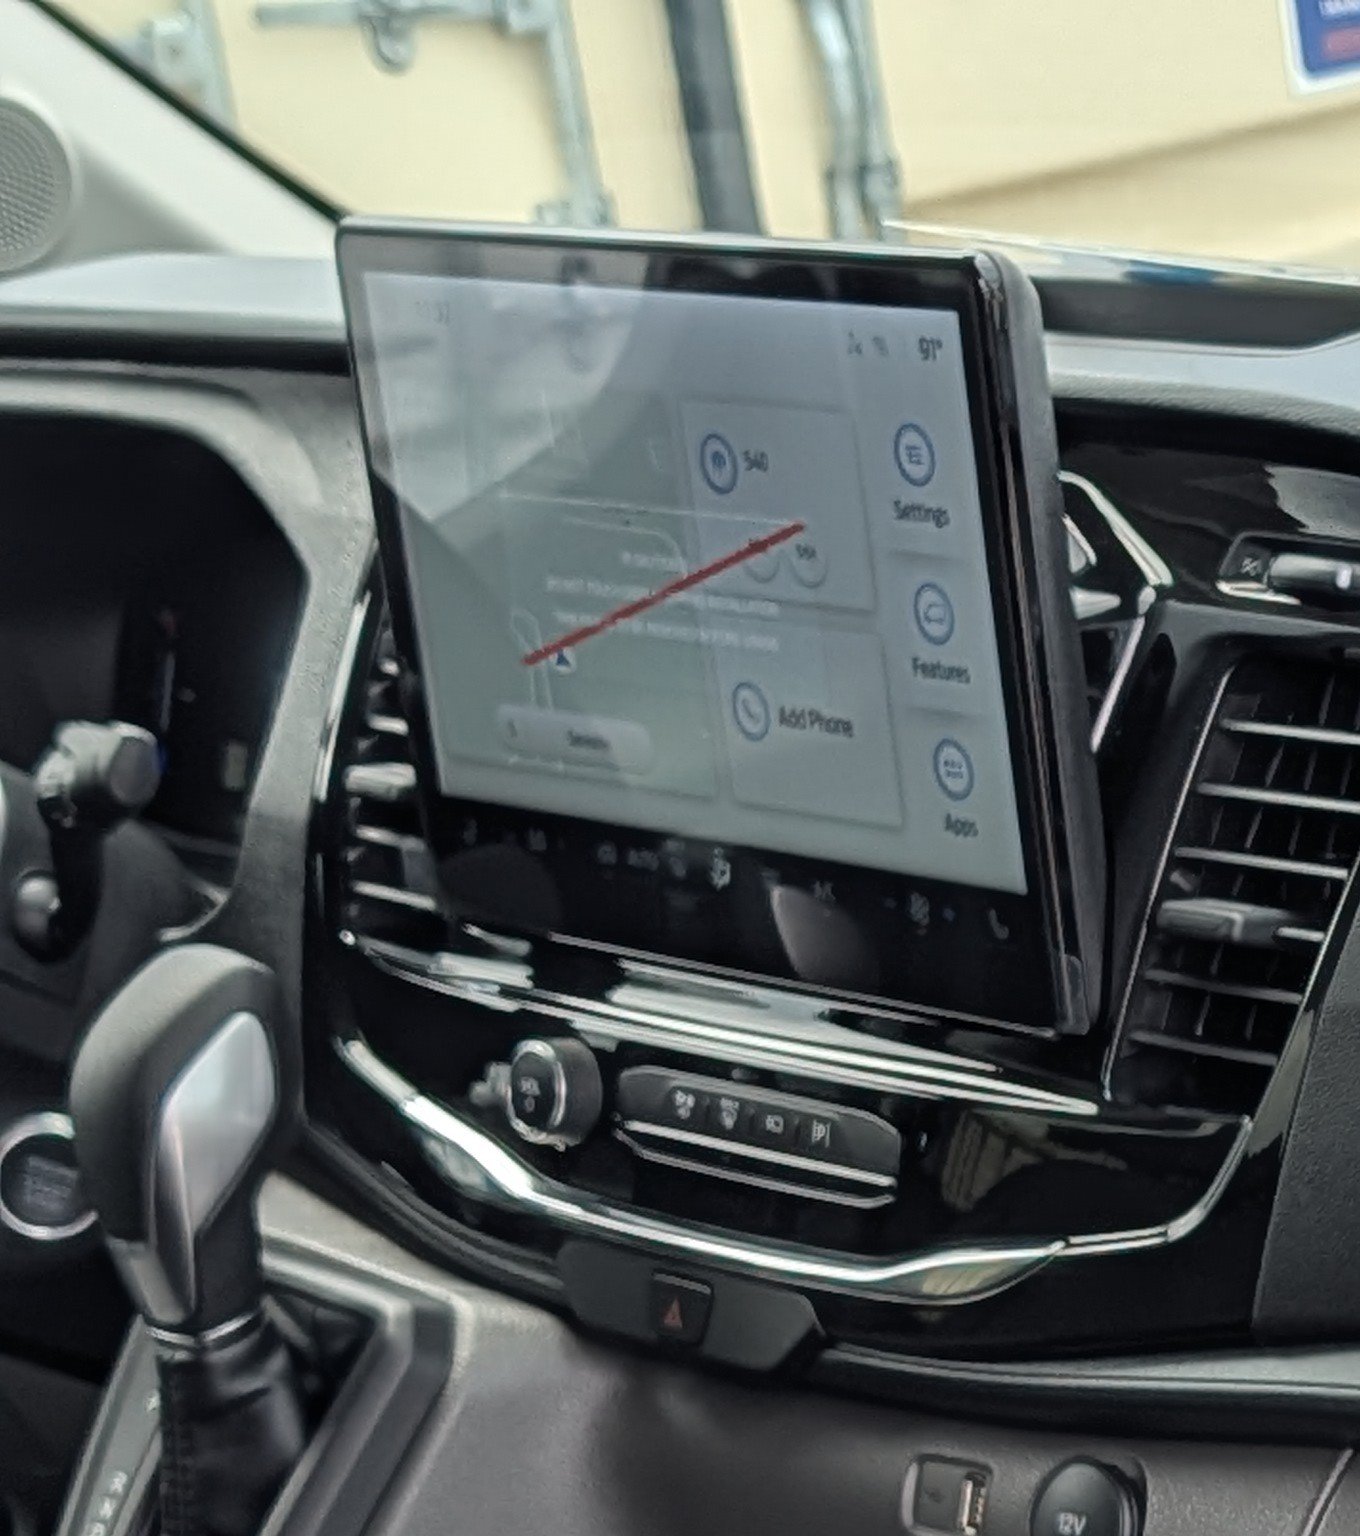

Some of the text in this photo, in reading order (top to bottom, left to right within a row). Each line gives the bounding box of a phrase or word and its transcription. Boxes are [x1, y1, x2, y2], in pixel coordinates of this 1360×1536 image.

[893, 500, 951, 529] Settings
[911, 656, 972, 684] Features
[778, 705, 854, 738] Add Phone
[944, 812, 979, 838] Apps
[1058, 1511, 1087, 1536] 12V
